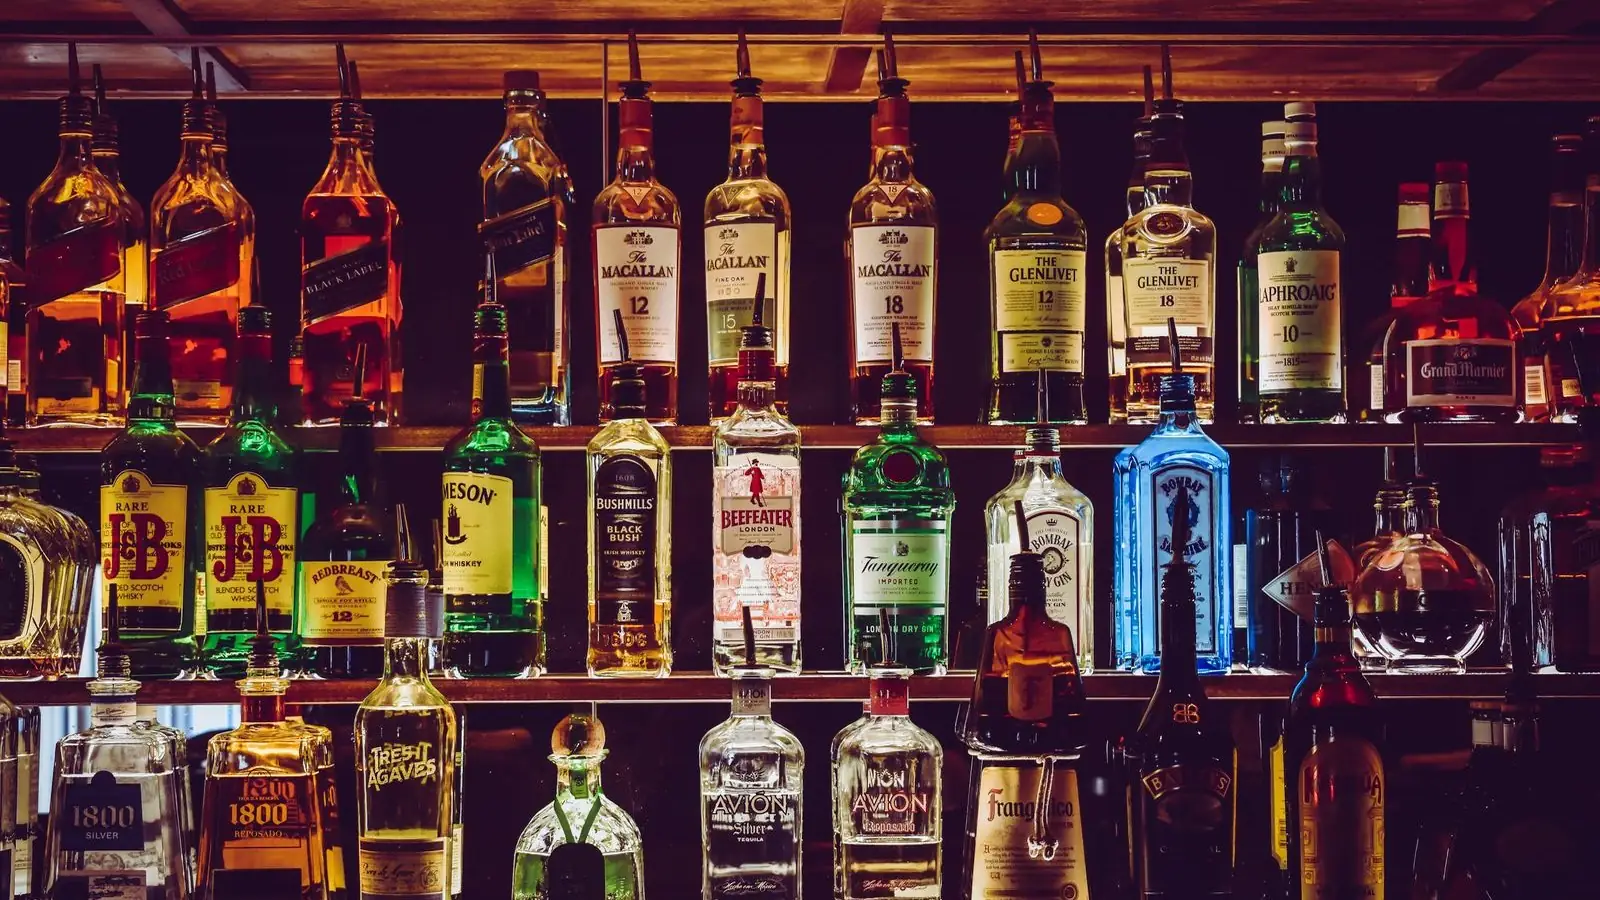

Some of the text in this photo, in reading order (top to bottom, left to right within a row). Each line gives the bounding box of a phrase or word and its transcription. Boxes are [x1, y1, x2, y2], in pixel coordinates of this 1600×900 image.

[719, 242, 736, 256] The
[882, 249, 902, 263] The
[627, 250, 647, 264] The
[1035, 257, 1057, 267] THE
[305, 275, 344, 295] BLACK
[346, 261, 383, 281] LABEL
[601, 264, 674, 279] MACALLAN
[858, 263, 931, 278] MACALLAN
[1009, 267, 1078, 282] GLENLIVET
[1159, 266, 1178, 275] THE
[1138, 275, 1198, 289] GLENLIVET
[884, 294, 904, 314] 18
[1037, 290, 1054, 304] 12
[1160, 294, 1175, 307] 18
[630, 296, 649, 315] 12
[722, 314, 736, 329] 15
[1283, 324, 1299, 343] 10
[1421, 361, 1505, 379] Grand Marnier
[116, 502, 148, 512] RARE
[230, 505, 265, 514] RARE
[597, 498, 653, 510] BUSHMILLS
[721, 509, 793, 529] BEEFEATER
[607, 525, 642, 533] BLACK
[1031, 534, 1073, 549] BOMBAY
[312, 564, 379, 584] REDBREAST
[861, 556, 939, 577] Tanqueray
[1053, 571, 1072, 588] GIN
[332, 611, 352, 622] 12
[902, 625, 918, 633] DRY
[921, 625, 934, 633] GIN
[712, 790, 789, 815] AVIÓN
[852, 789, 927, 813] AVIÓN
[73, 805, 135, 828] 1800
[229, 802, 288, 825] 1800
[234, 830, 283, 838] REPOSADO
[733, 822, 765, 835] Silver
